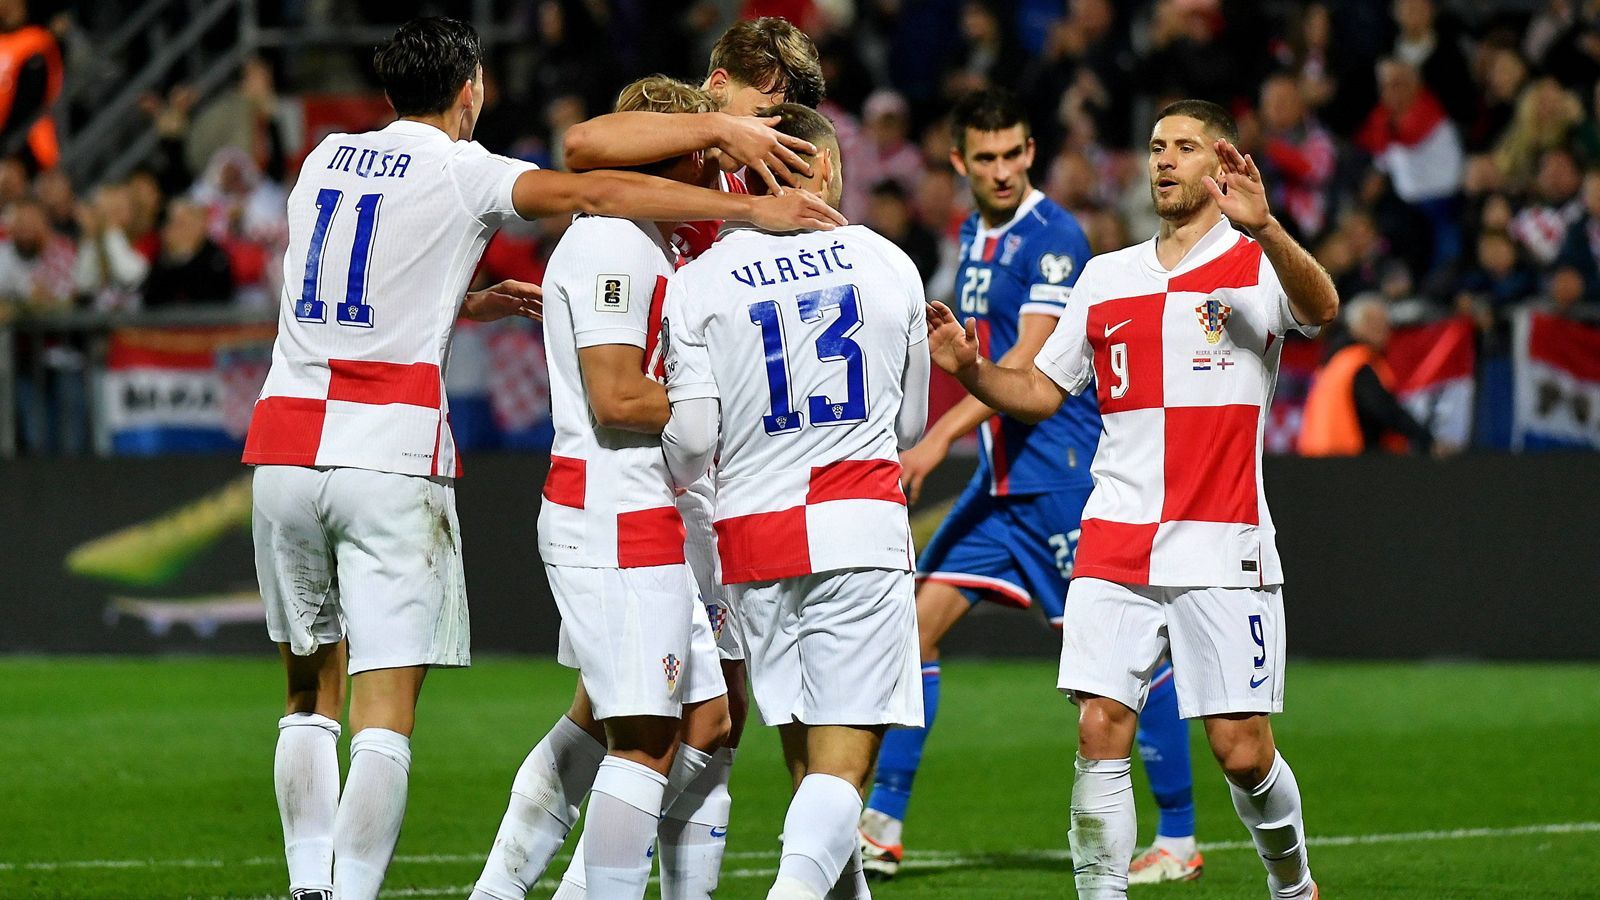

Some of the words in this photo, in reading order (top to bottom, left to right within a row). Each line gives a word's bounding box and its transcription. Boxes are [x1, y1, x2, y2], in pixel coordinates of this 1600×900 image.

[327, 145, 412, 178] MUSA
[295, 188, 385, 328] 11
[730, 240, 853, 288] VLAŠIĆ
[960, 266, 992, 315] 22
[747, 283, 870, 437] 13
[1110, 342, 1130, 399] 9
[1248, 614, 1266, 669] 9
